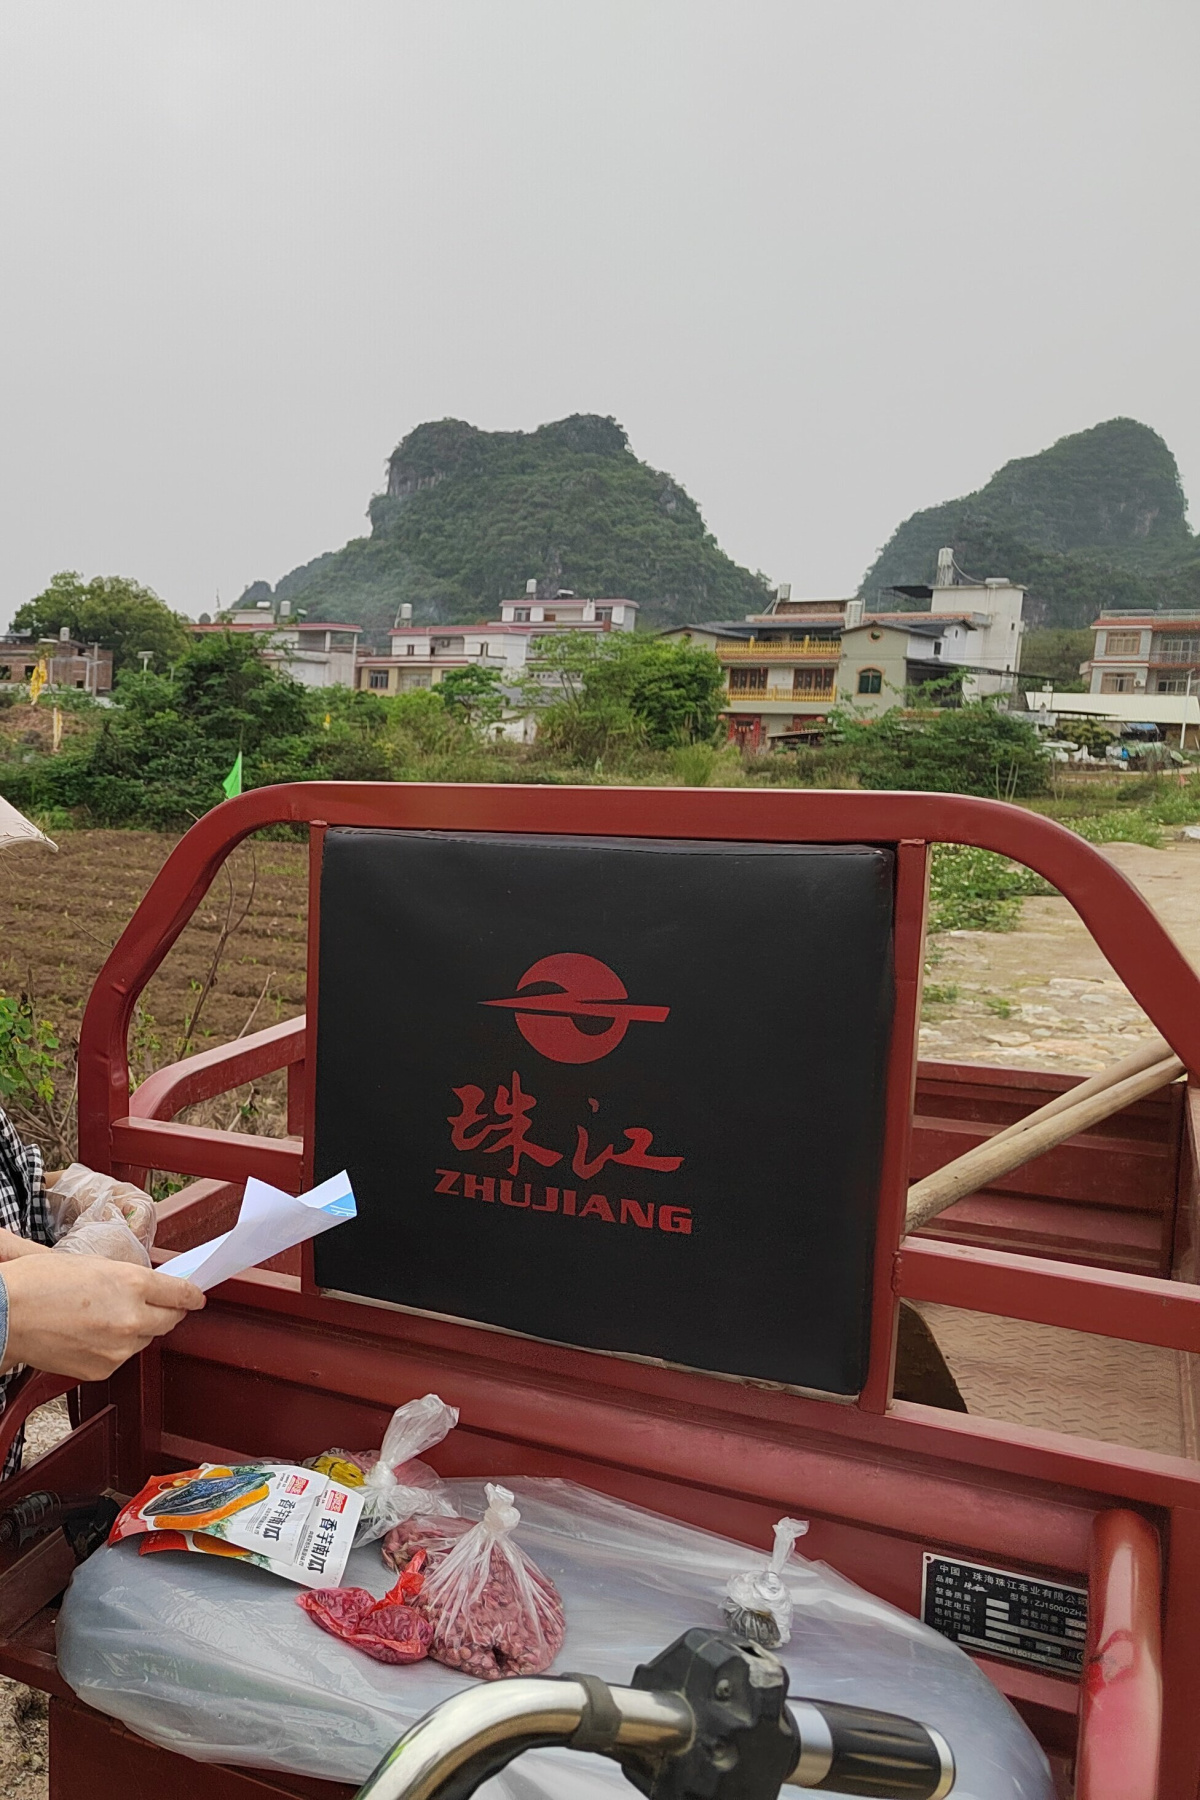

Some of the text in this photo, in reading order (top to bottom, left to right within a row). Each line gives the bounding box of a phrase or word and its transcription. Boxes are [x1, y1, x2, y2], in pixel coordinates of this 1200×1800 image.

[447, 1070, 685, 1180] 珠江
[434, 1168, 693, 1235] ZHUJIANG
[263, 1499, 297, 1542] 香芋南瓜
[307, 1518, 338, 1574] 香芋南瓜
